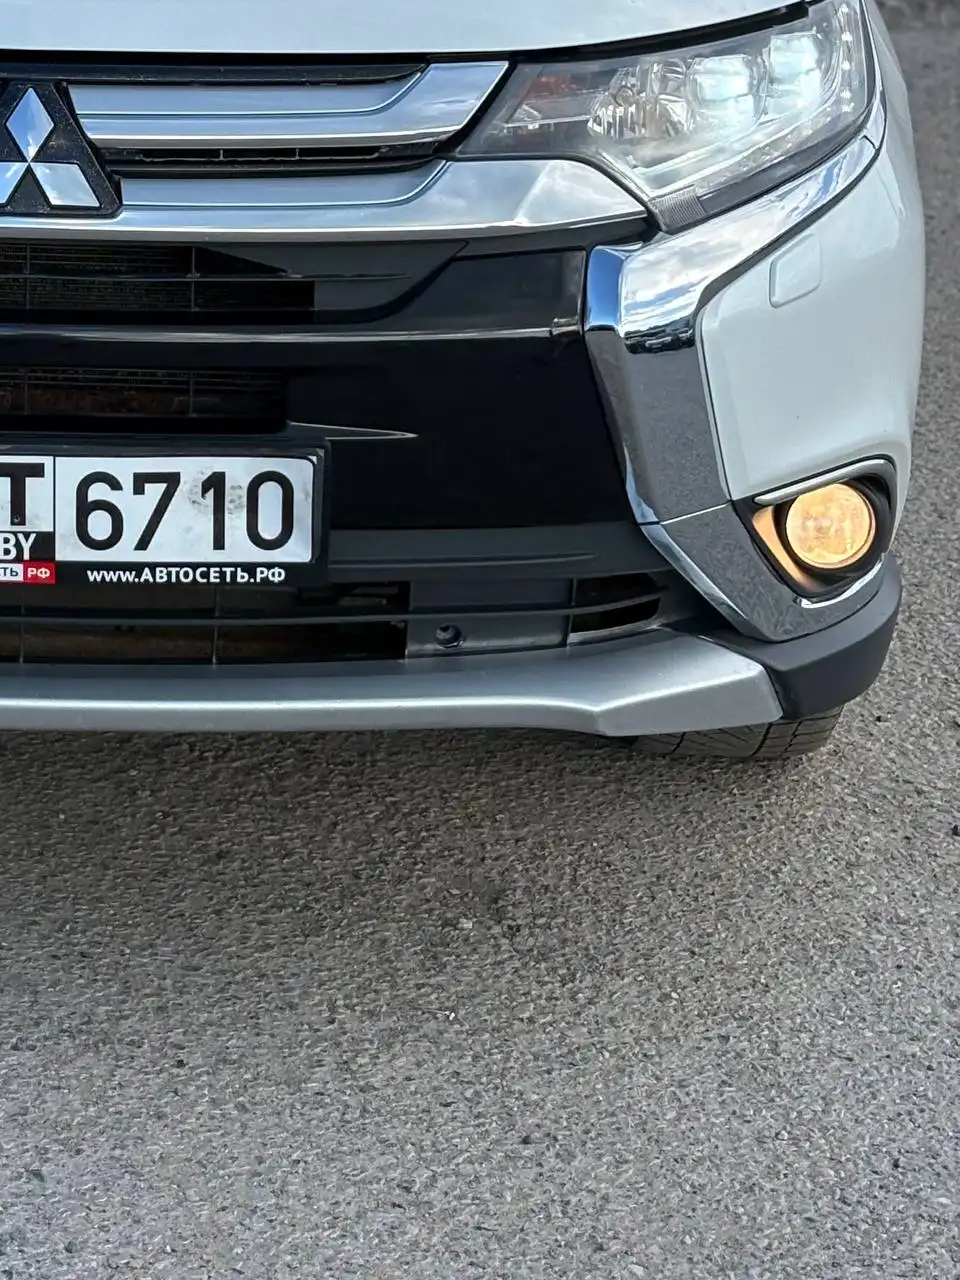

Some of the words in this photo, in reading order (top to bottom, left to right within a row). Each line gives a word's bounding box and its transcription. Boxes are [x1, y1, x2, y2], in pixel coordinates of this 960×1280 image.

[74, 470, 295, 552] 6710
[27, 566, 51, 581] РФ
[87, 566, 286, 585] www.АВТОСЕТЬ.РФ
